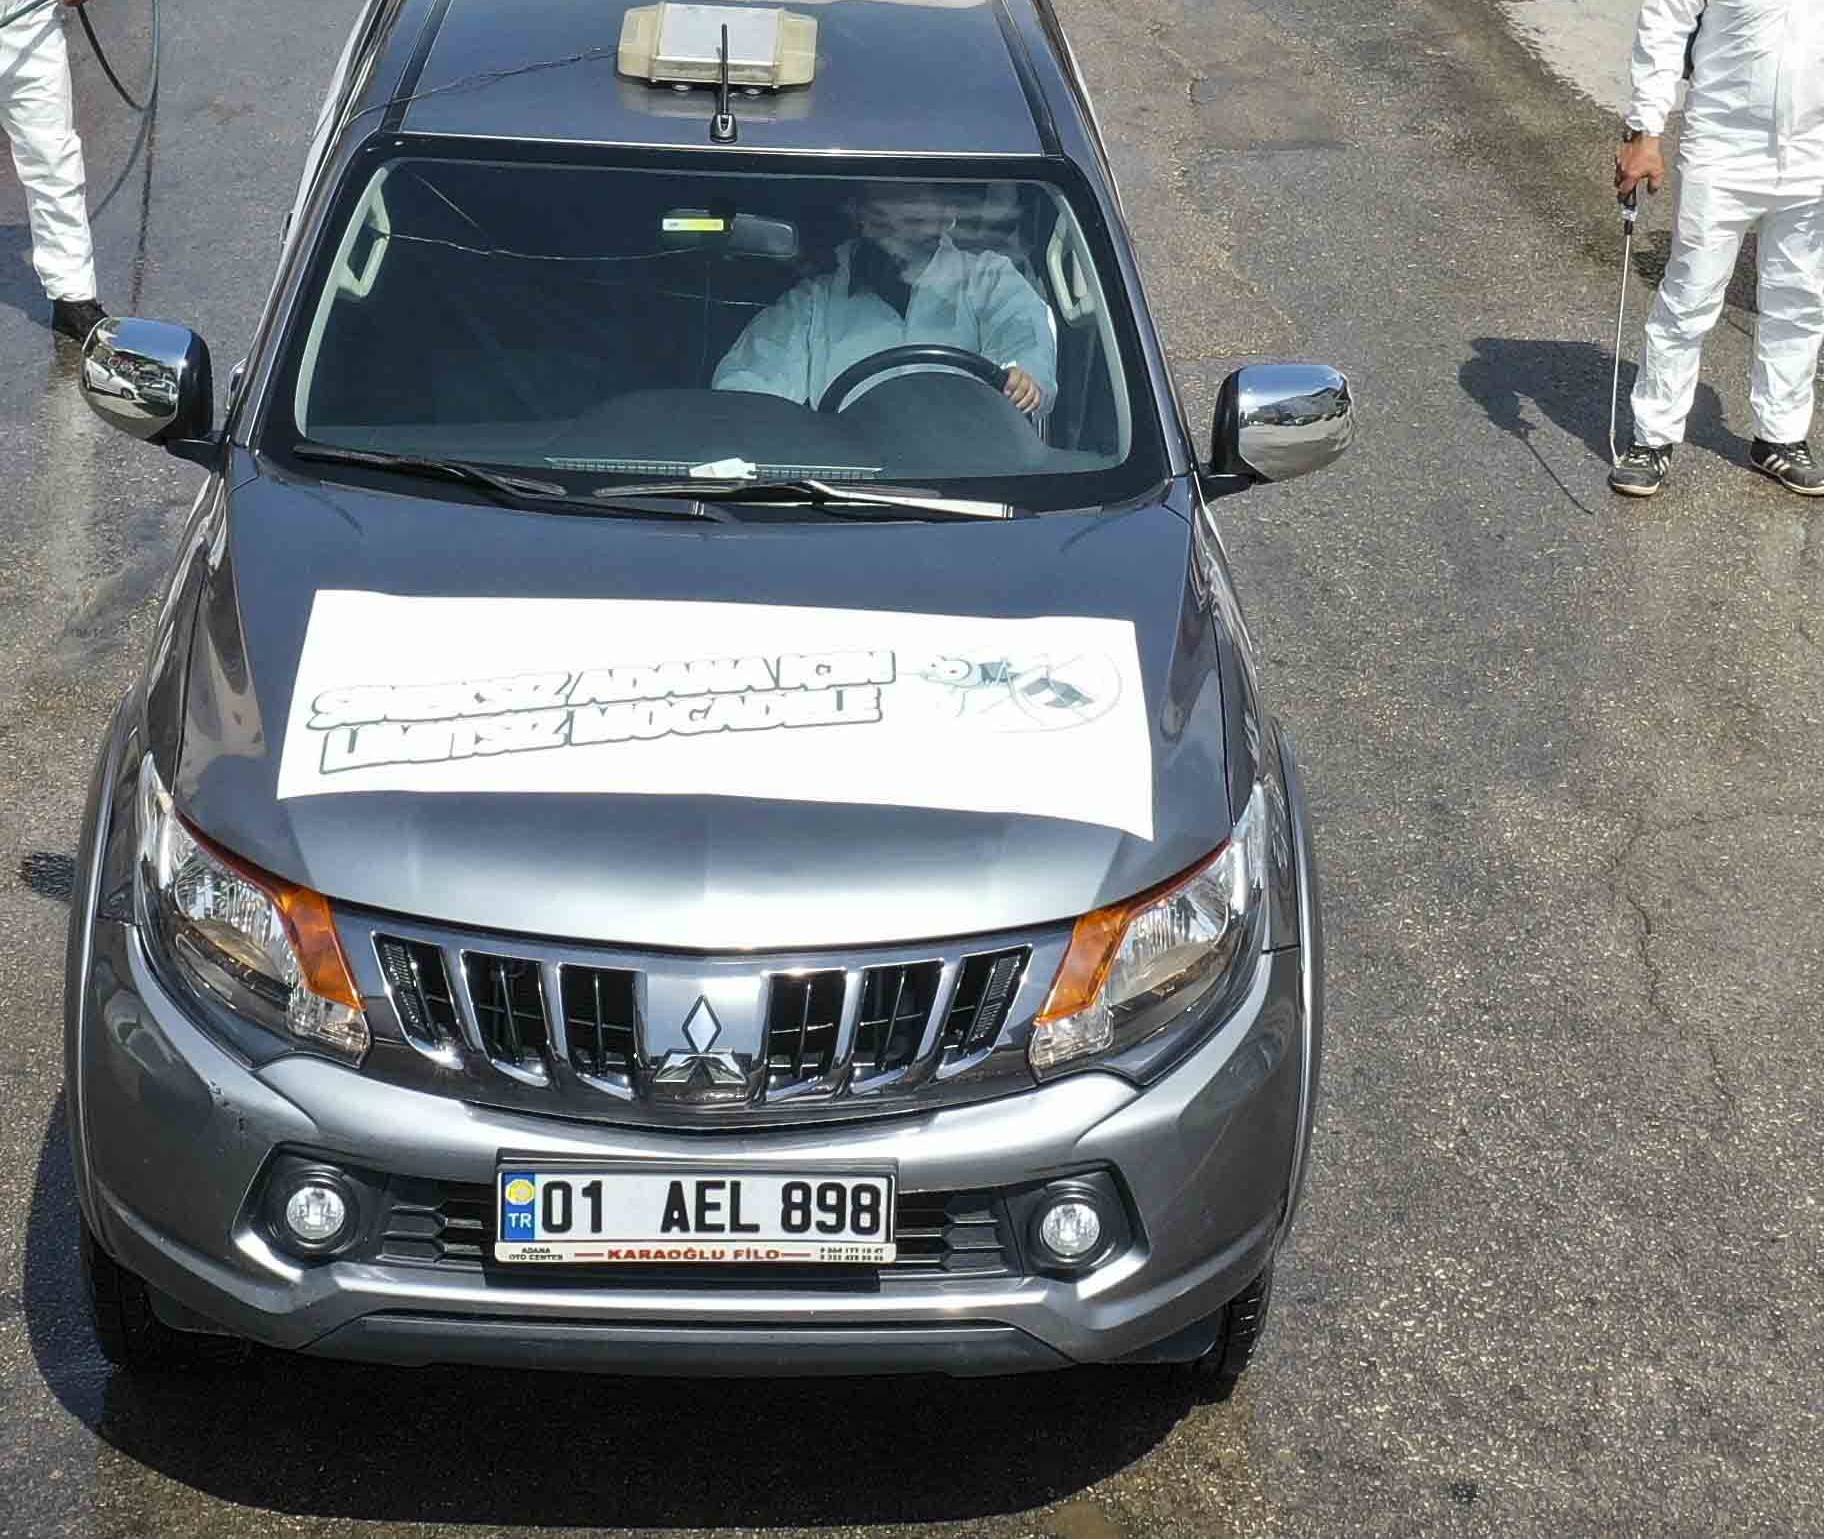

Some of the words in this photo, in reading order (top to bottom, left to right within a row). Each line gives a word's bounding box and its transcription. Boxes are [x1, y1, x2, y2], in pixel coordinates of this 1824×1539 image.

[541, 1179, 604, 1235] 01
[659, 1179, 761, 1235] AEL
[779, 1180, 882, 1236] 898
[507, 1211, 533, 1229] TR
[607, 1245, 726, 1261] KARAOĞLU
[733, 1245, 781, 1261] FİLO
